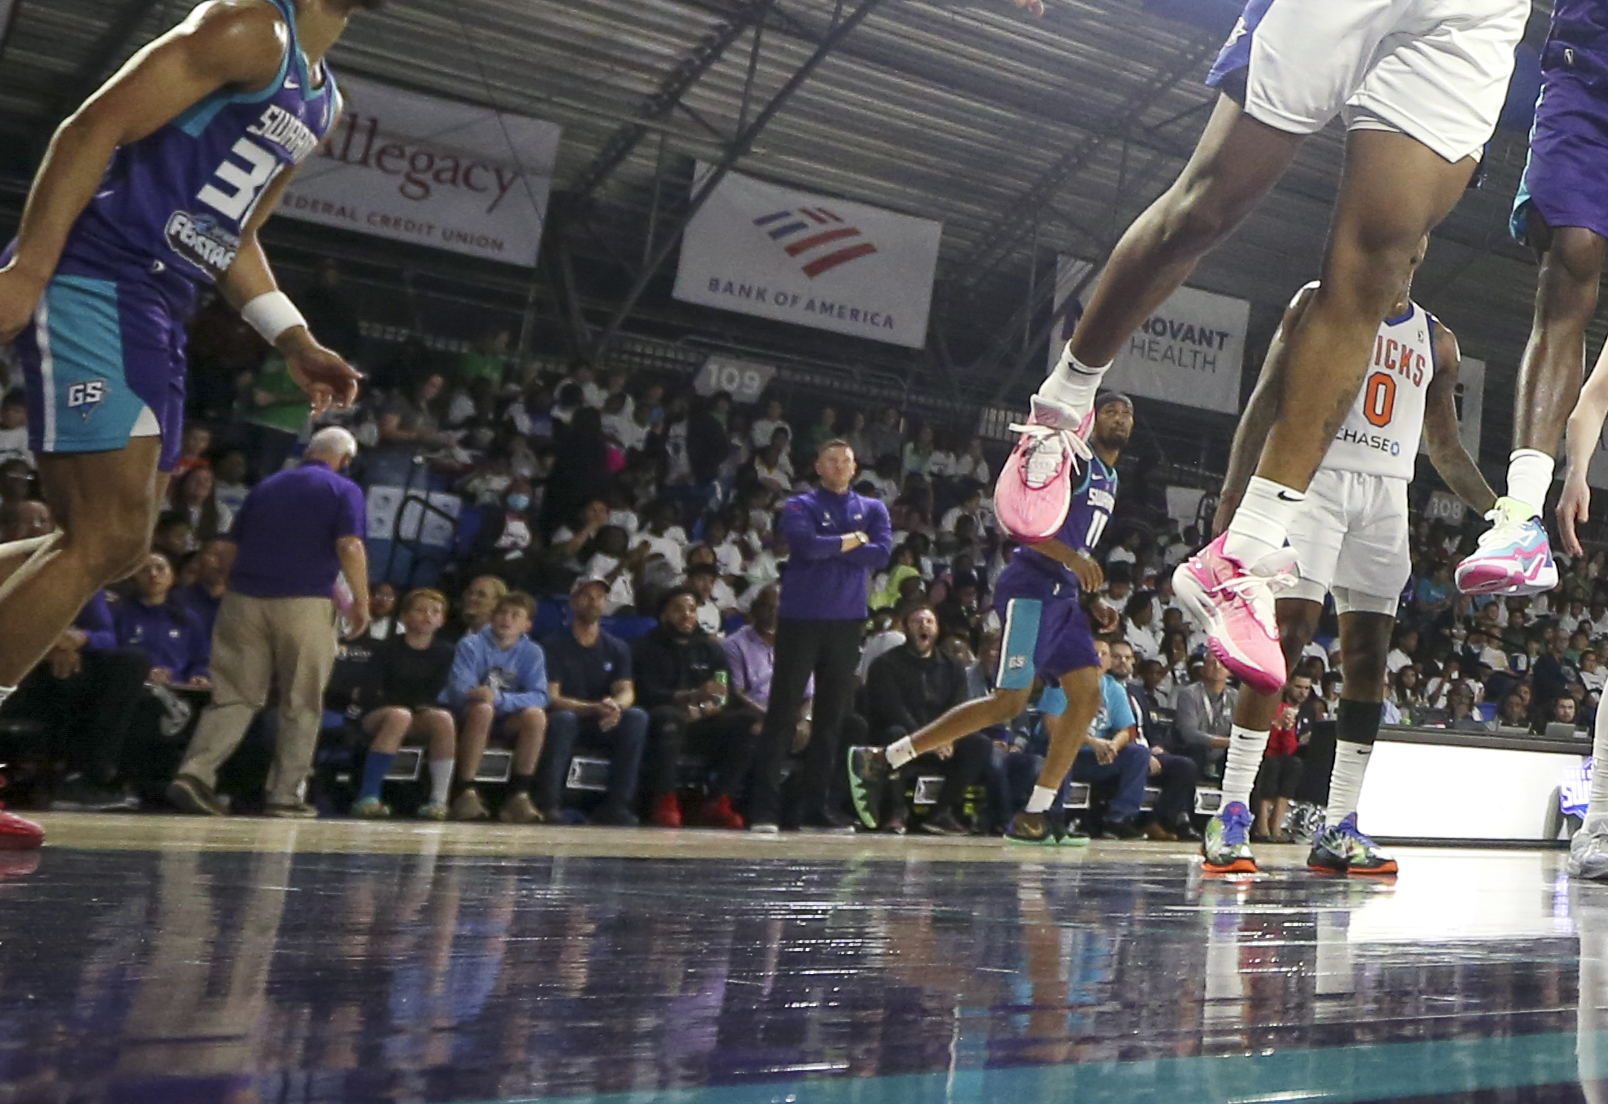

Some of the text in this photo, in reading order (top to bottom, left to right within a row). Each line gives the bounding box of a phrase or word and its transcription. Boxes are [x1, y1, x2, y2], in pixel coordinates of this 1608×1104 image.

[283, 193, 505, 251] EDERAL CREDIT UNION
[707, 277, 894, 330] BANK OF AMERICA
[1130, 336, 1217, 374] HEALTH
[1374, 335, 1426, 387] ICKS
[68, 382, 102, 407] GS
[706, 363, 761, 394] 109
[1363, 371, 1397, 428] 0
[1086, 509, 1109, 549] 11
